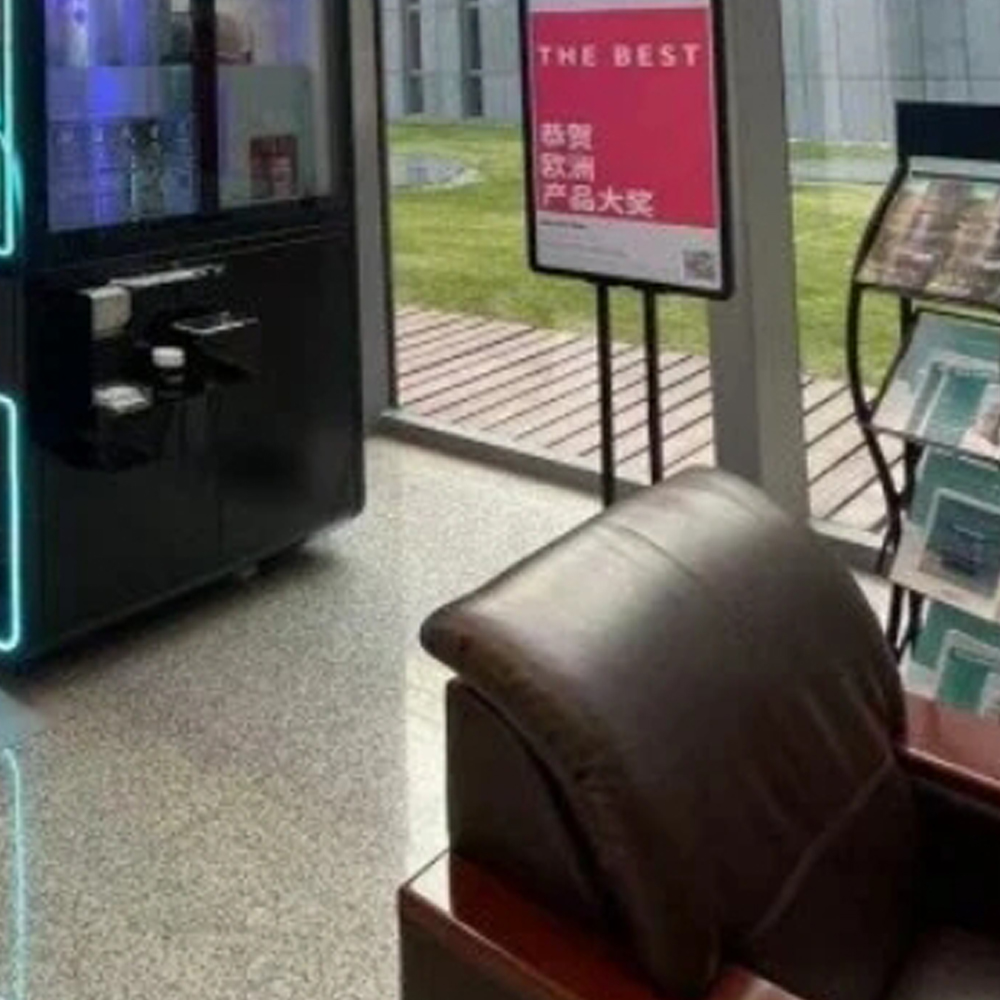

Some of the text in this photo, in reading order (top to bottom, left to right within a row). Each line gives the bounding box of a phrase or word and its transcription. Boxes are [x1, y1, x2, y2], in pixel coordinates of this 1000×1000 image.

[537, 43, 701, 68] THE BEST
[541, 123, 593, 150] 恭贺
[541, 152, 595, 182] 欧洲
[541, 184, 655, 218] 产品大奖
